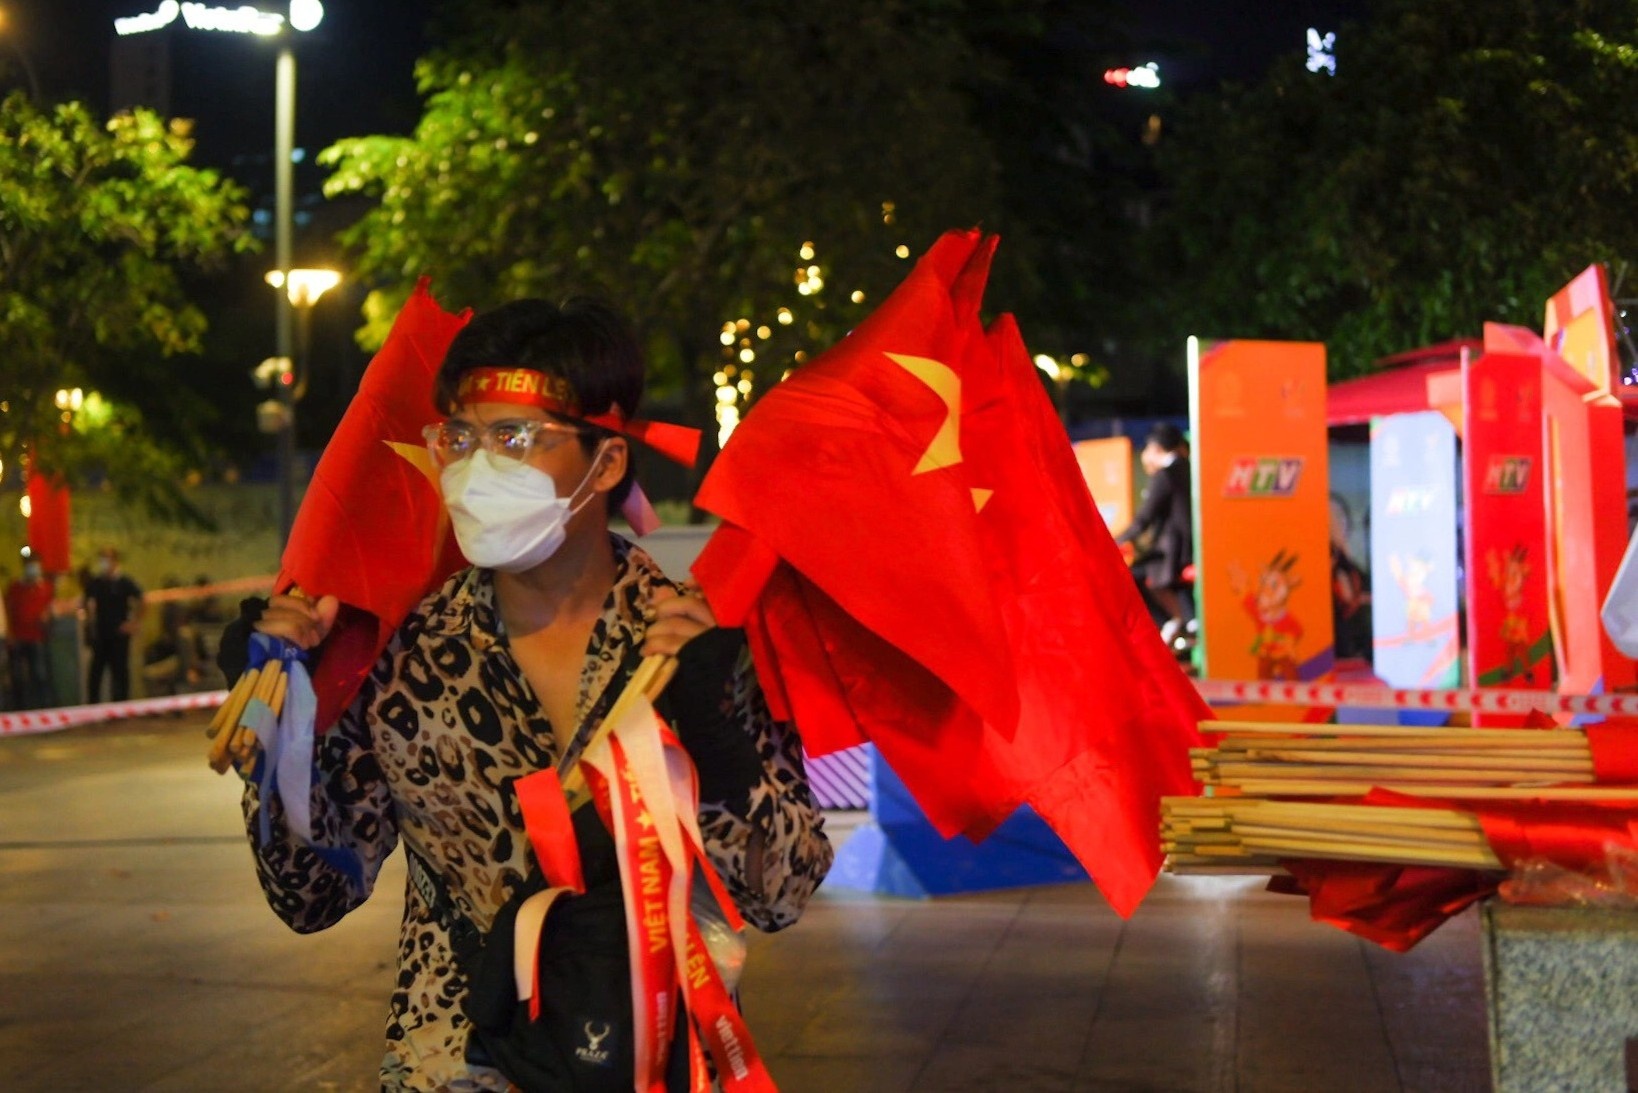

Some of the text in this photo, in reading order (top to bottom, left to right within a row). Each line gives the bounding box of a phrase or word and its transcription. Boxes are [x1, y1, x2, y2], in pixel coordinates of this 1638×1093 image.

[1226, 459, 1301, 496] HTV
[1486, 458, 1530, 492] HTV
[639, 836, 662, 896] NAM
